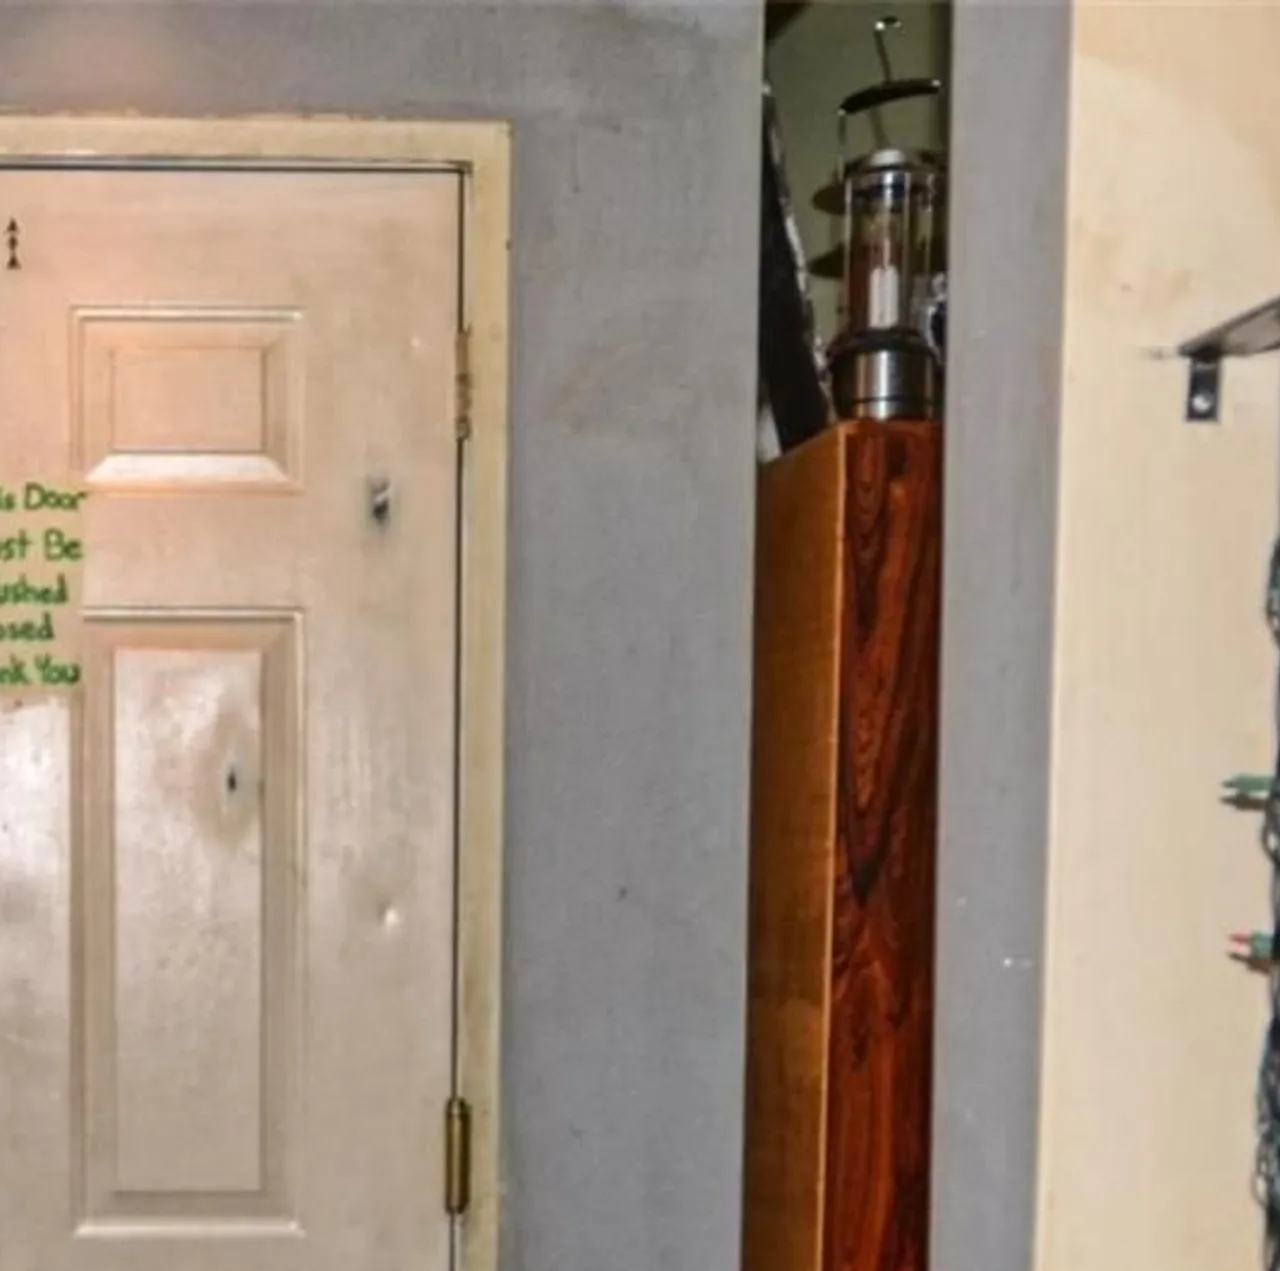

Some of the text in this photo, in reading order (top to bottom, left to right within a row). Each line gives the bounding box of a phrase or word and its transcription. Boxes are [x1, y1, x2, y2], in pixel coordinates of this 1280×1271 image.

[24, 481, 87, 511] Door
[44, 528, 82, 561] Be
[35, 652, 81, 685] You
